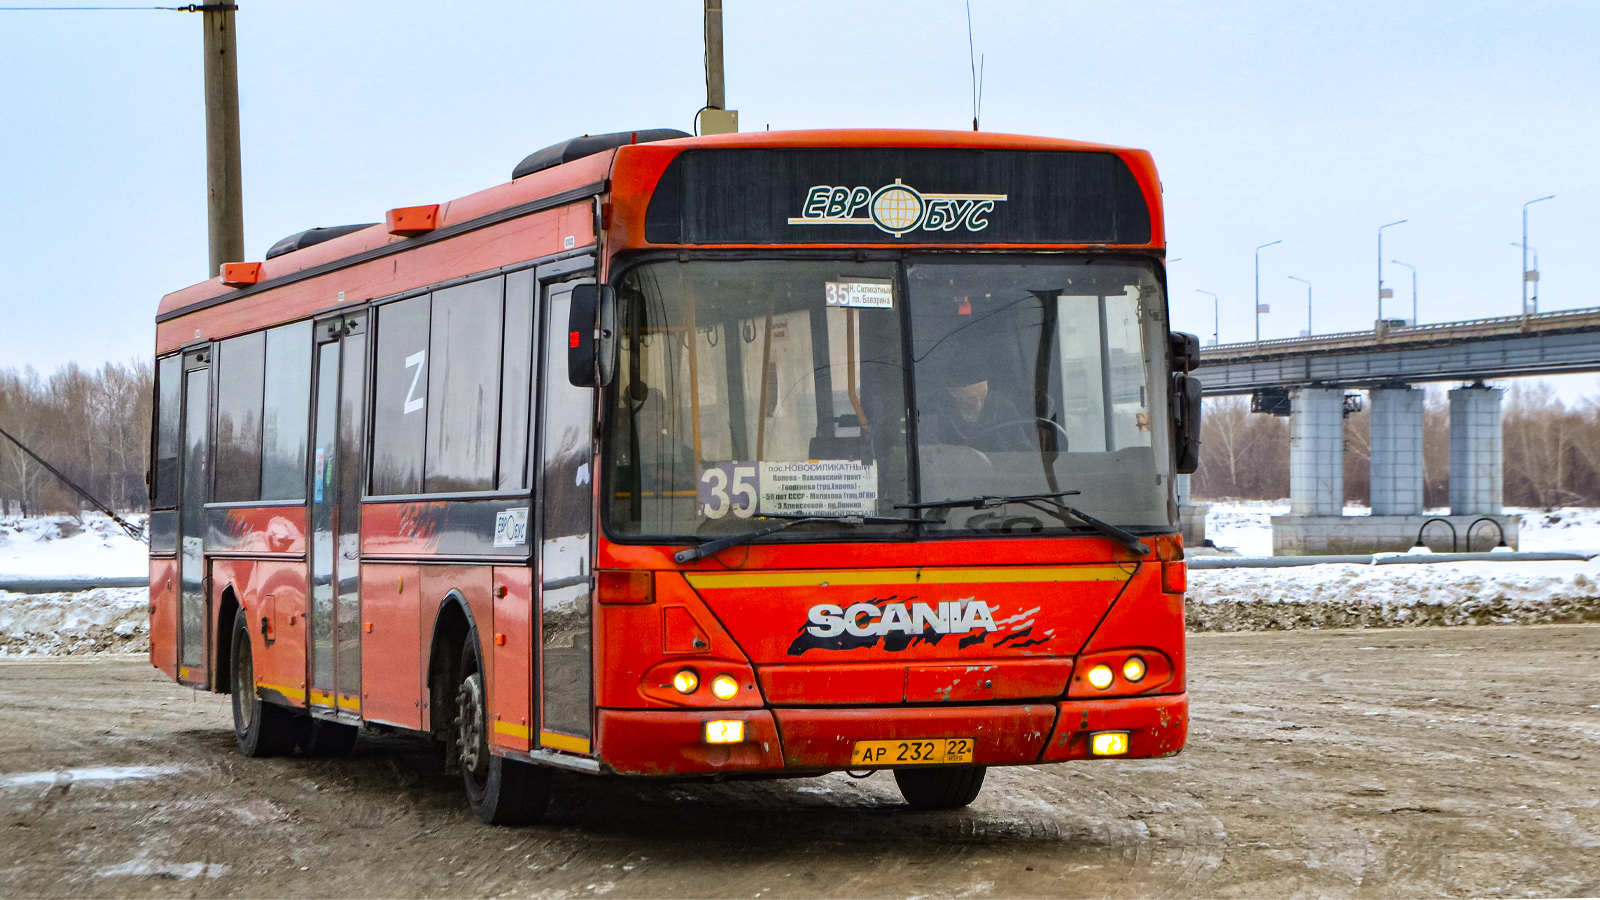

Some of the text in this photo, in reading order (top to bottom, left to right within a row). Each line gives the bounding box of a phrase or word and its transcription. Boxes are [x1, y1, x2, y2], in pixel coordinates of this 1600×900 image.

[826, 283, 849, 304] 35
[849, 284, 892, 294] Н. Силикатный
[851, 295, 890, 306] пл. Баварина
[404, 349, 425, 415] Z
[773, 473, 861, 482] Попова Павловский тракт
[701, 467, 758, 519] 35
[781, 483, 815, 492] Георгиева
[775, 493, 787, 501] лет
[788, 493, 805, 501] СССР
[809, 492, 842, 501] Малахова
[806, 600, 998, 638] SCANIA
[896, 742, 935, 761] 232
[947, 740, 967, 755] 22
